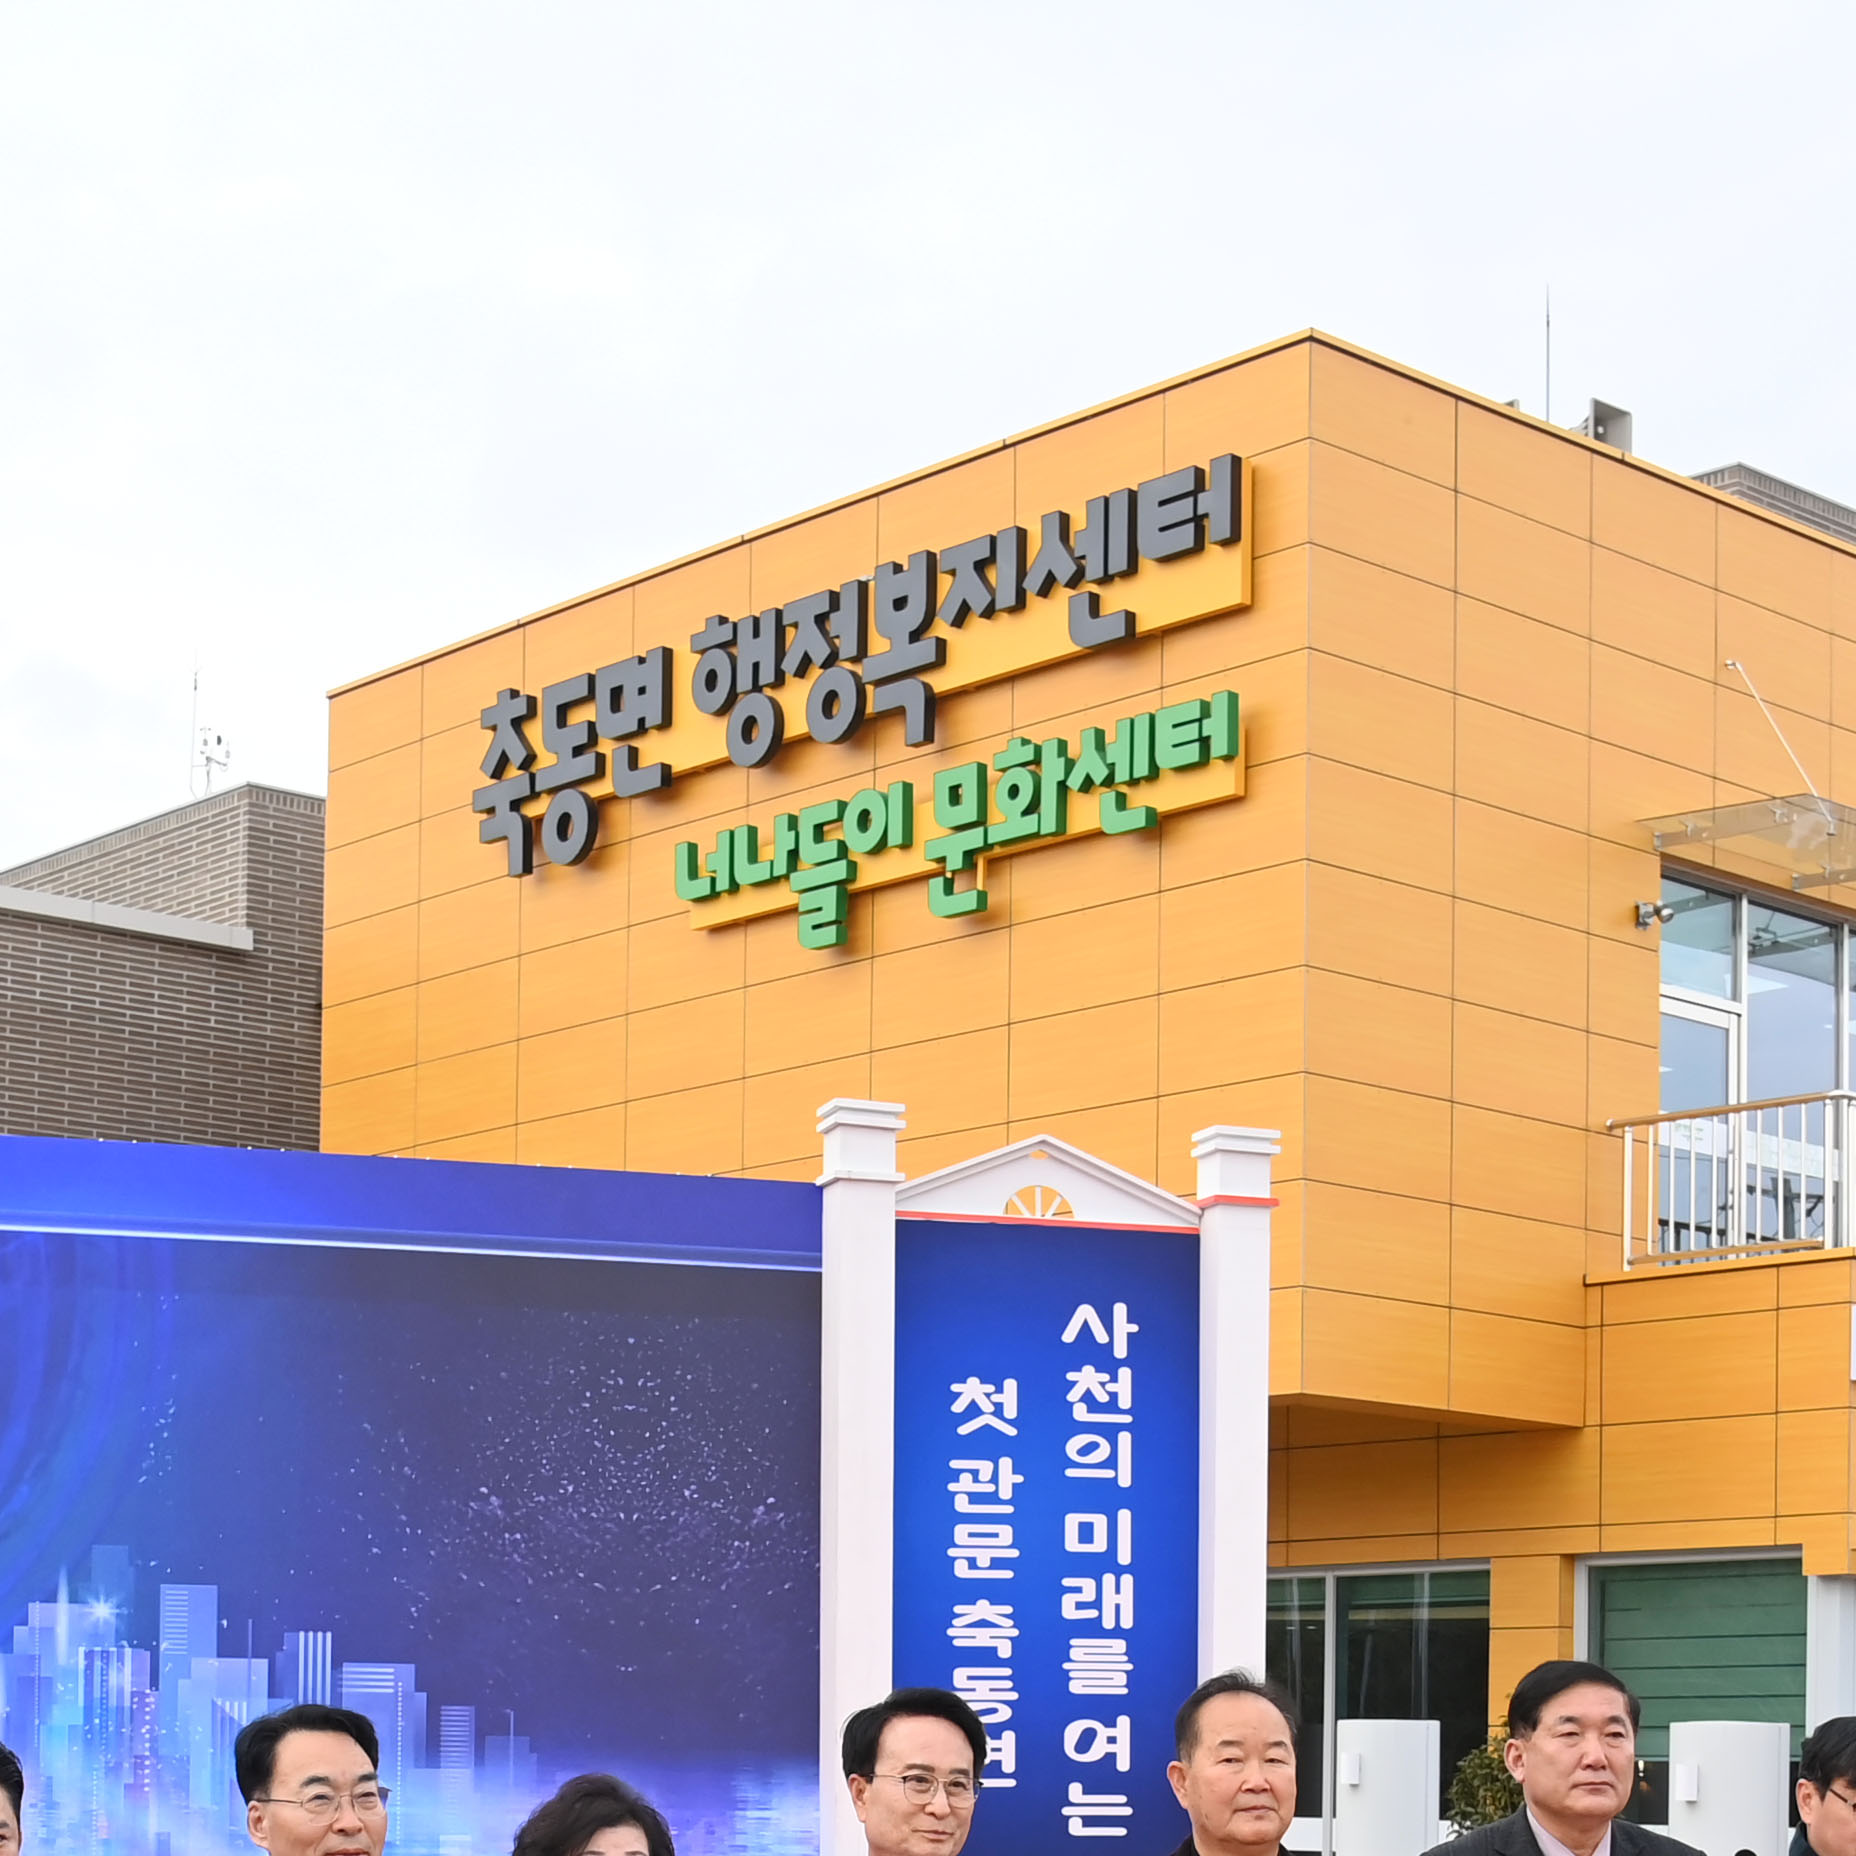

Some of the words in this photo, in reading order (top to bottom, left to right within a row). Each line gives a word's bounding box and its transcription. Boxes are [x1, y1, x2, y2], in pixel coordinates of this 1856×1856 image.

[472, 645, 673, 877] 축동면
[690, 453, 1242, 769] 행정복지센터
[674, 780, 914, 950] 너나들이
[924, 690, 1240, 919] 문화센터
[949, 1375, 1019, 1438] 첫
[1060, 1301, 1139, 1489] 사천의
[946, 1455, 1024, 1580] 관문
[1060, 1507, 1134, 1696] 미래를
[1060, 1713, 1134, 1838] 여는
